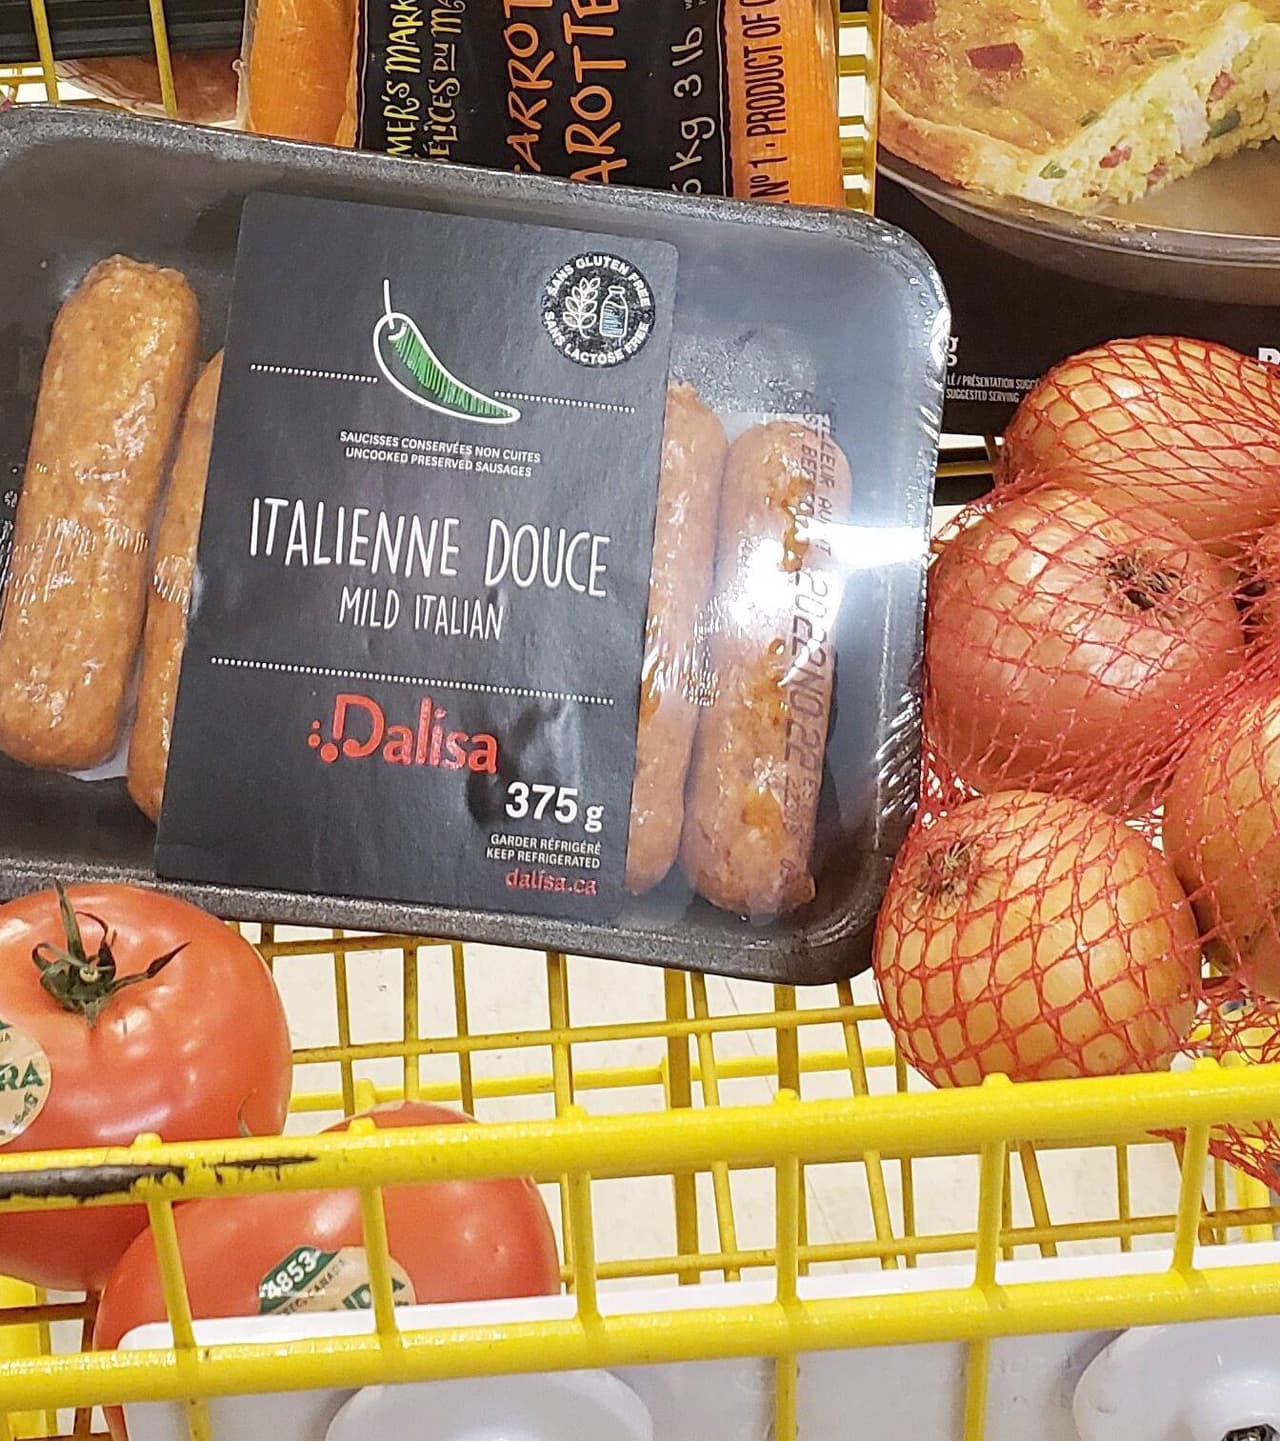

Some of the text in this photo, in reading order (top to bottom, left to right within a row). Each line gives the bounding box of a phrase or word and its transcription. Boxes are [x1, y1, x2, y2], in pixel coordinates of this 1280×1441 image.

[671, 25, 704, 67] lb
[740, 13, 783, 40] OF
[673, 73, 703, 98] 3
[743, 44, 789, 138] PRODUCT
[381, 80, 421, 158] MER'S
[546, 255, 652, 308] SANS GLUTEN FREE
[543, 311, 650, 365] SANS LACTOSE FREE
[945, 388, 1020, 403] SUGGESTED SERVING
[339, 430, 541, 464] SAUCISSES CONSERVÉES NON CUITES
[345, 446, 532, 478] UNCOOKED PRESERVED SAUSAGES
[249, 496, 612, 599] ITALIENNE DOUCE
[338, 585, 506, 641] MILD ITALIAN
[327, 693, 499, 775] Dalisa
[504, 780, 580, 825] 375
[485, 846, 602, 870] KEEP REFRIGERATED
[489, 832, 602, 857] GARDER RÉFRIGÉRÉ
[503, 867, 599, 897] dalisa.ca
